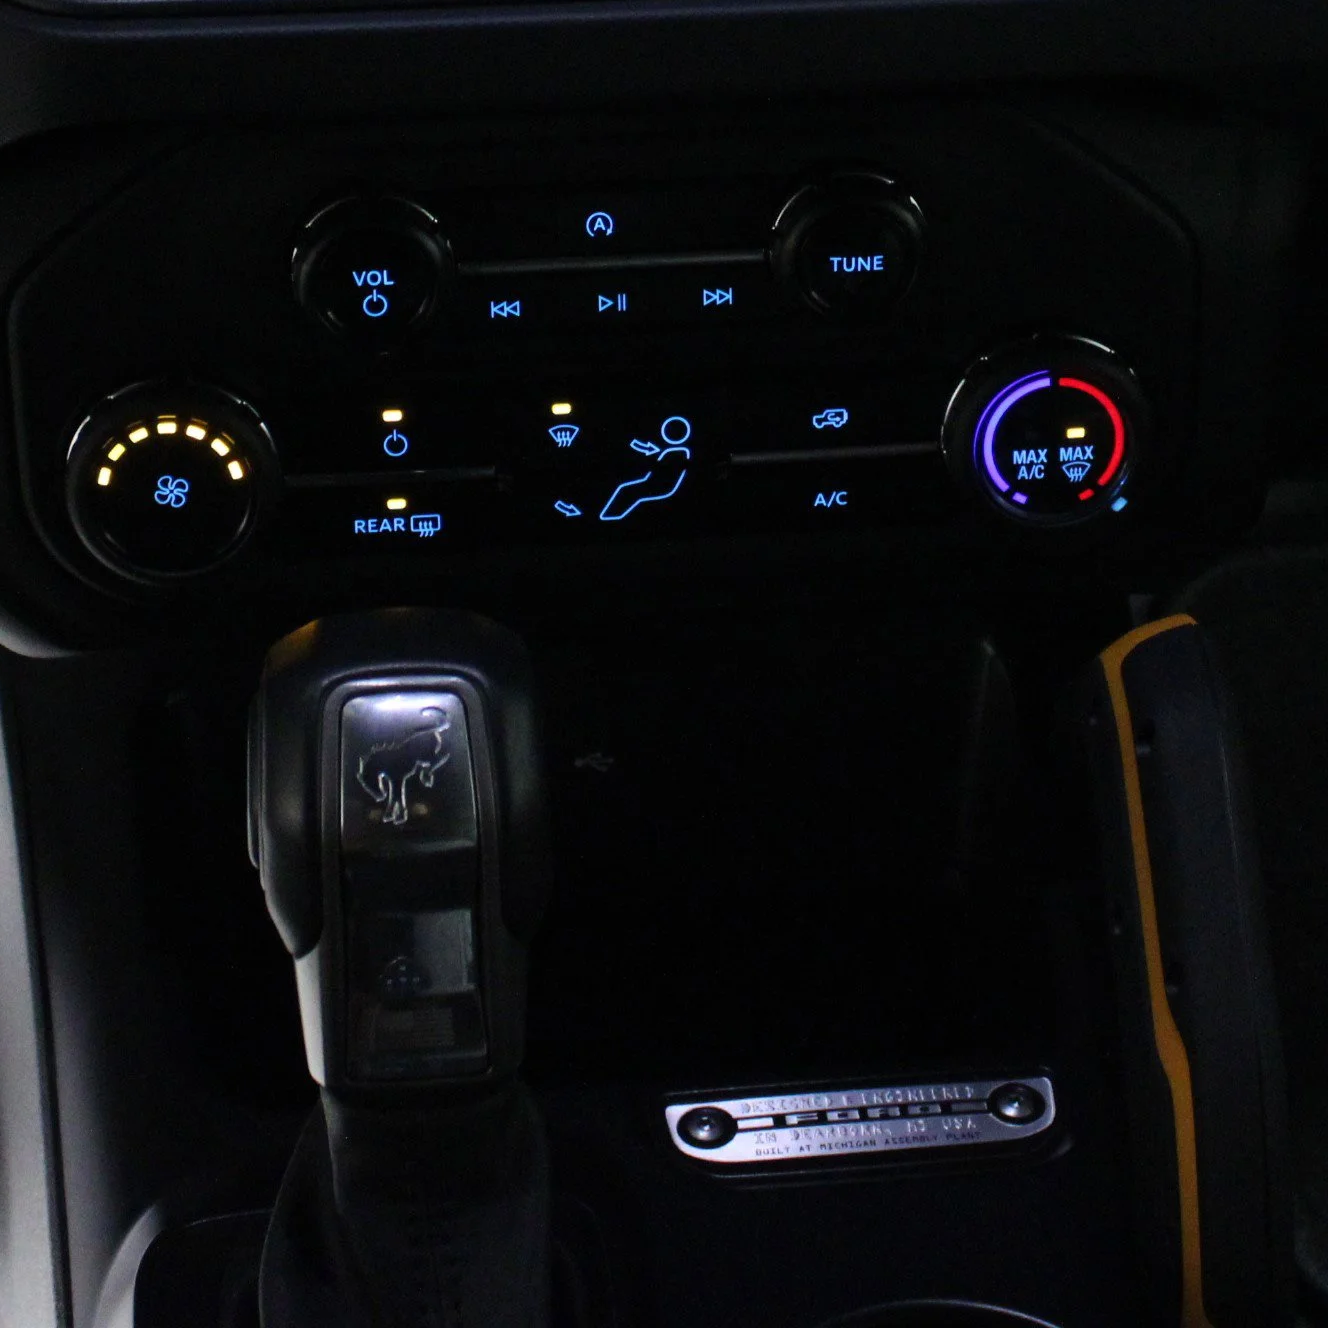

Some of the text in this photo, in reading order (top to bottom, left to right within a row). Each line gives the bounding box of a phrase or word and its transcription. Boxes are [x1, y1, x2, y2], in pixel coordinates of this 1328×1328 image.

[829, 255, 884, 272] TUNE
[353, 270, 394, 286] VOL
[1013, 449, 1048, 464] MAX
[1059, 445, 1094, 461] MAX
[1018, 465, 1045, 480] A/C
[814, 492, 848, 507] A/C
[354, 518, 405, 533] REAR
[942, 1117, 977, 1131] USA
[755, 1131, 981, 1157] BUILT AT MICHIGAN ASSEMBLY PLANT
